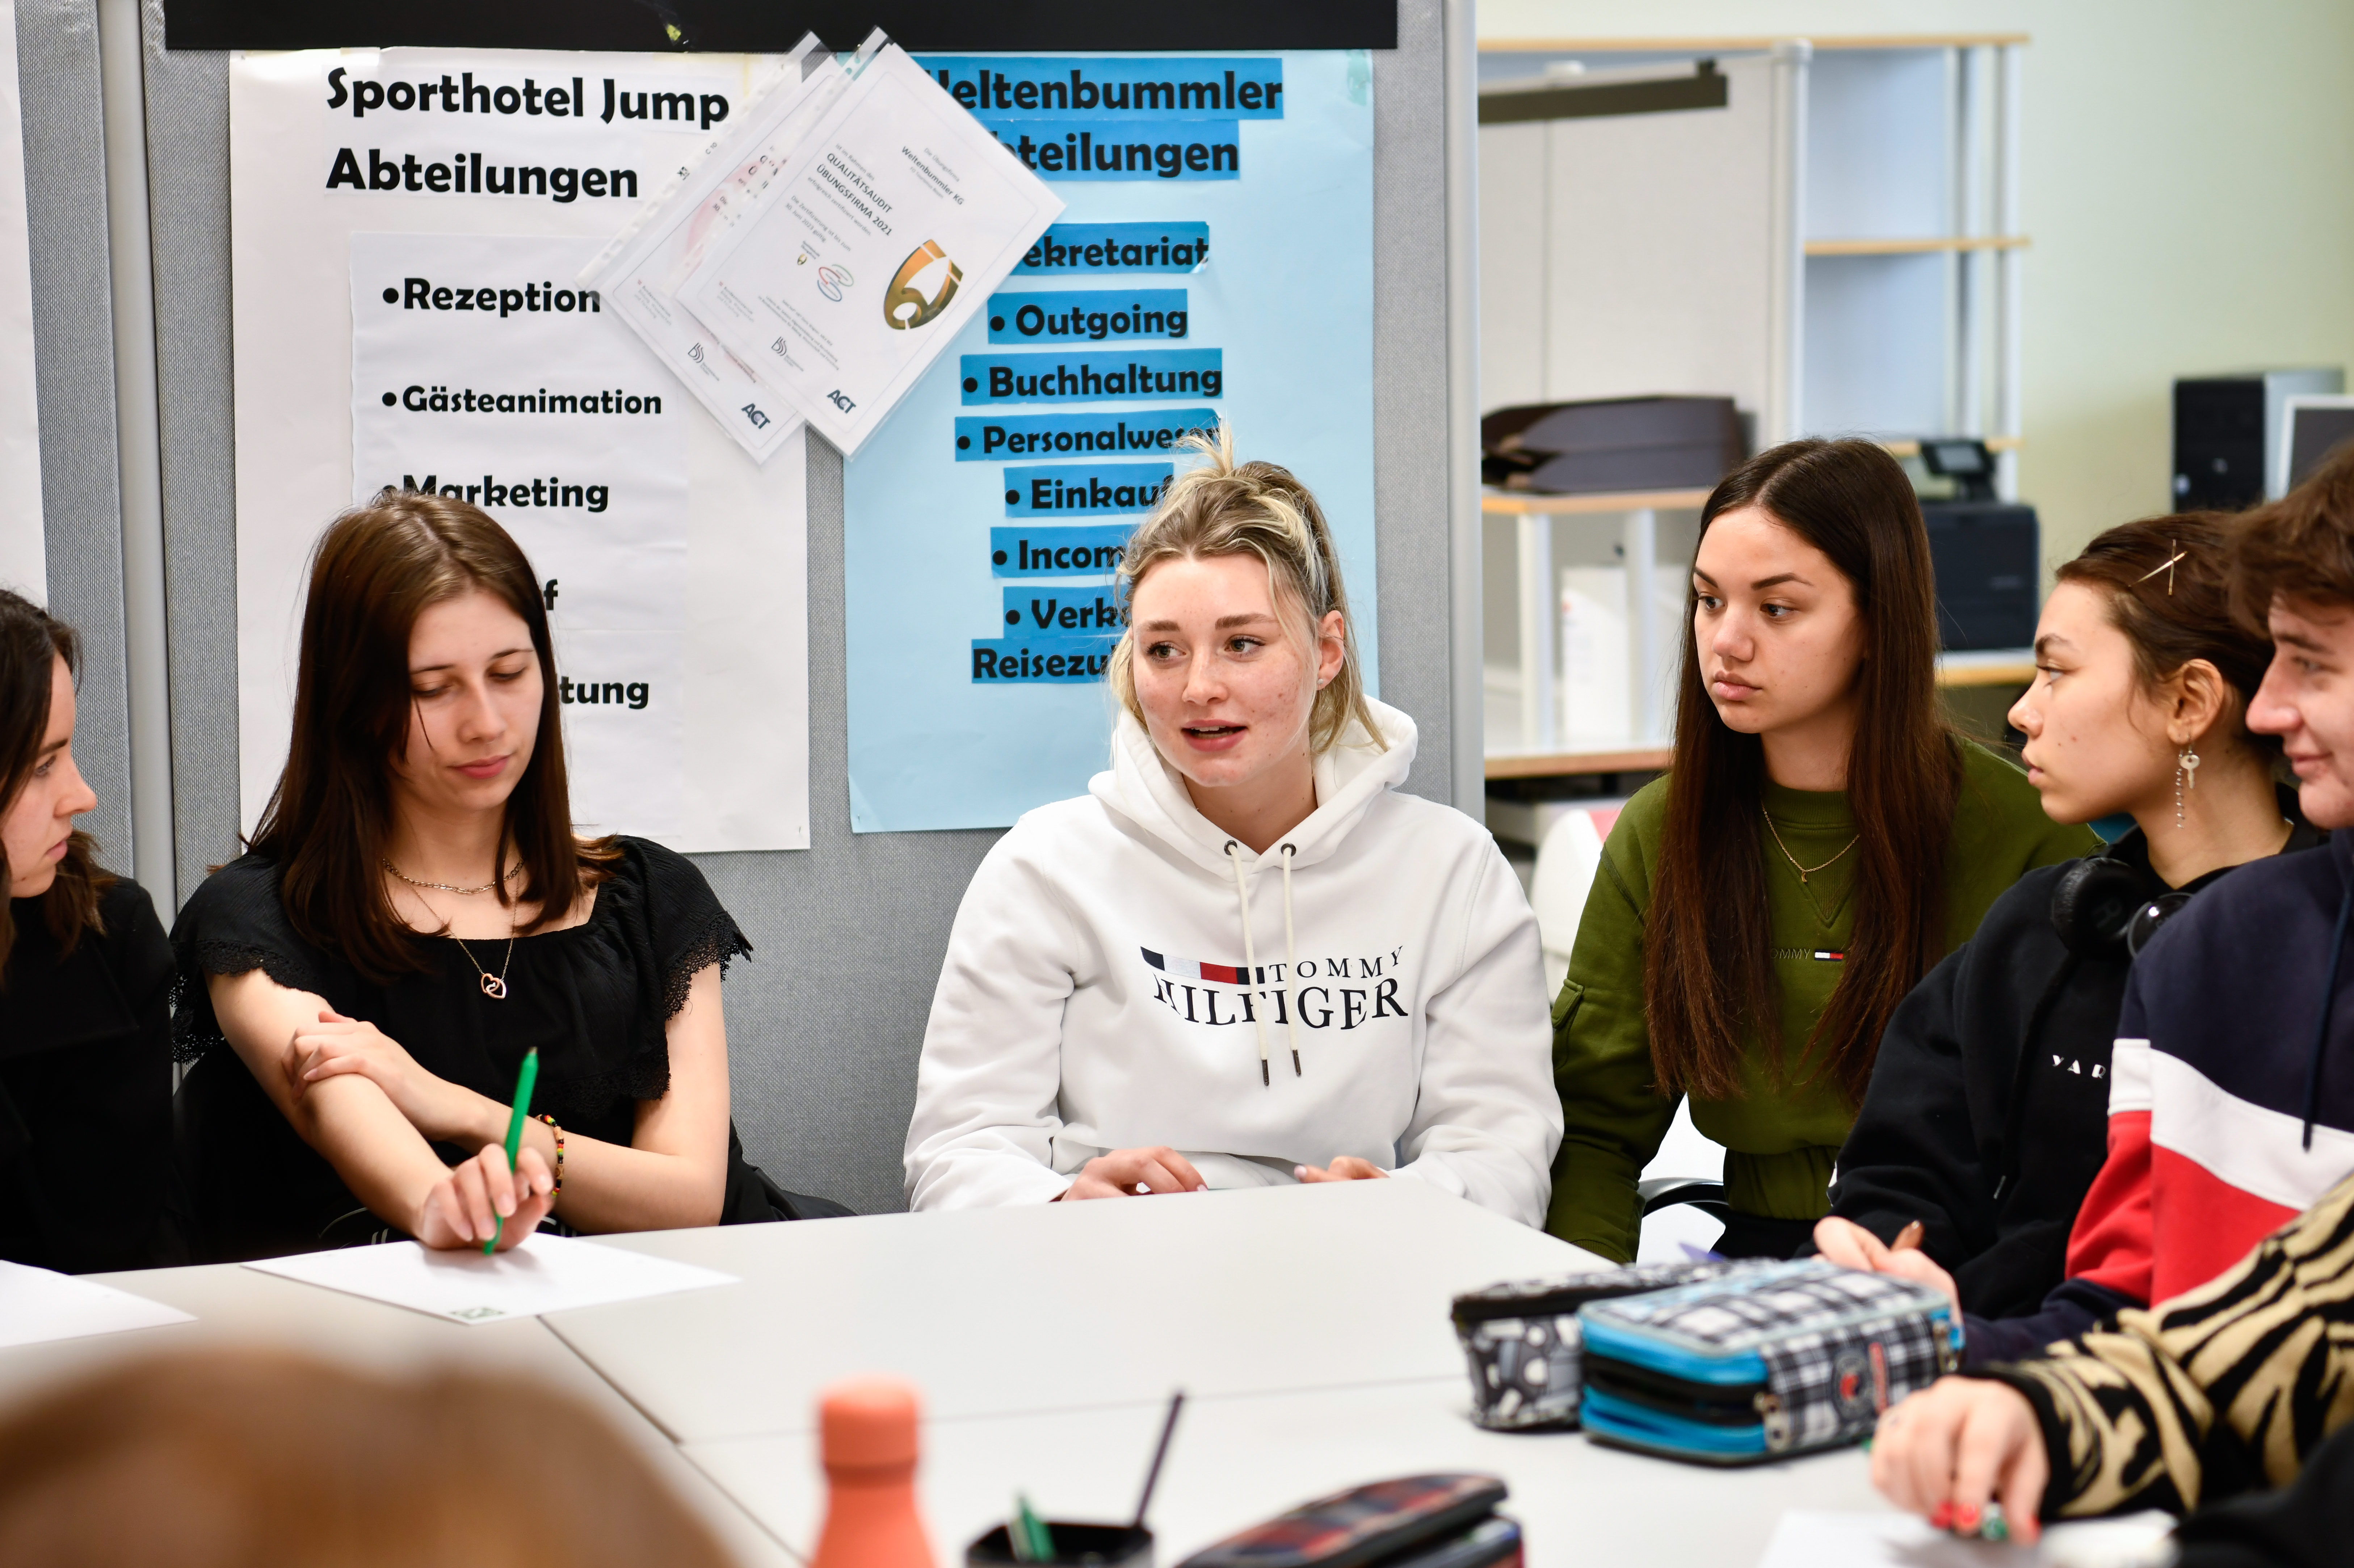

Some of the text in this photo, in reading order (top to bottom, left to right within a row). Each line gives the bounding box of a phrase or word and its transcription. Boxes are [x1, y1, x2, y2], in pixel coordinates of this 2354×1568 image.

[328, 68, 728, 130] Sporthotel Jump
[925, 69, 1282, 110] eltenbummler
[848, 155, 866, 173] Rahmen
[989, 131, 1238, 178] teilungen
[326, 148, 637, 202] Abteilungen
[807, 177, 831, 199] erfolgreich
[827, 153, 892, 213] QUALITÄTSAUDIT
[901, 146, 964, 205] Weltenbummler KG
[816, 164, 873, 219] ÜBUNGSFIRMA
[872, 216, 892, 236] 2021
[791, 195, 799, 204] Die
[798, 203, 828, 232] Zertifizierung
[840, 241, 851, 252] zum
[801, 218, 814, 230] 2023
[1023, 236, 1208, 267] ekretariat
[404, 278, 600, 317] Rezeption
[1016, 304, 1187, 340] Outgoing
[989, 363, 1222, 397] Buchhaltung
[403, 386, 661, 413] Gästeanimation
[741, 402, 770, 429] ACT
[826, 389, 856, 414] ACT
[403, 475, 609, 513] Marketing
[1019, 540, 1126, 570] Incom
[1031, 597, 1131, 629] Verk
[973, 645, 1117, 678] Reisezu
[1269, 946, 1403, 982] TOMMY
[1770, 948, 1810, 960] OMMY
